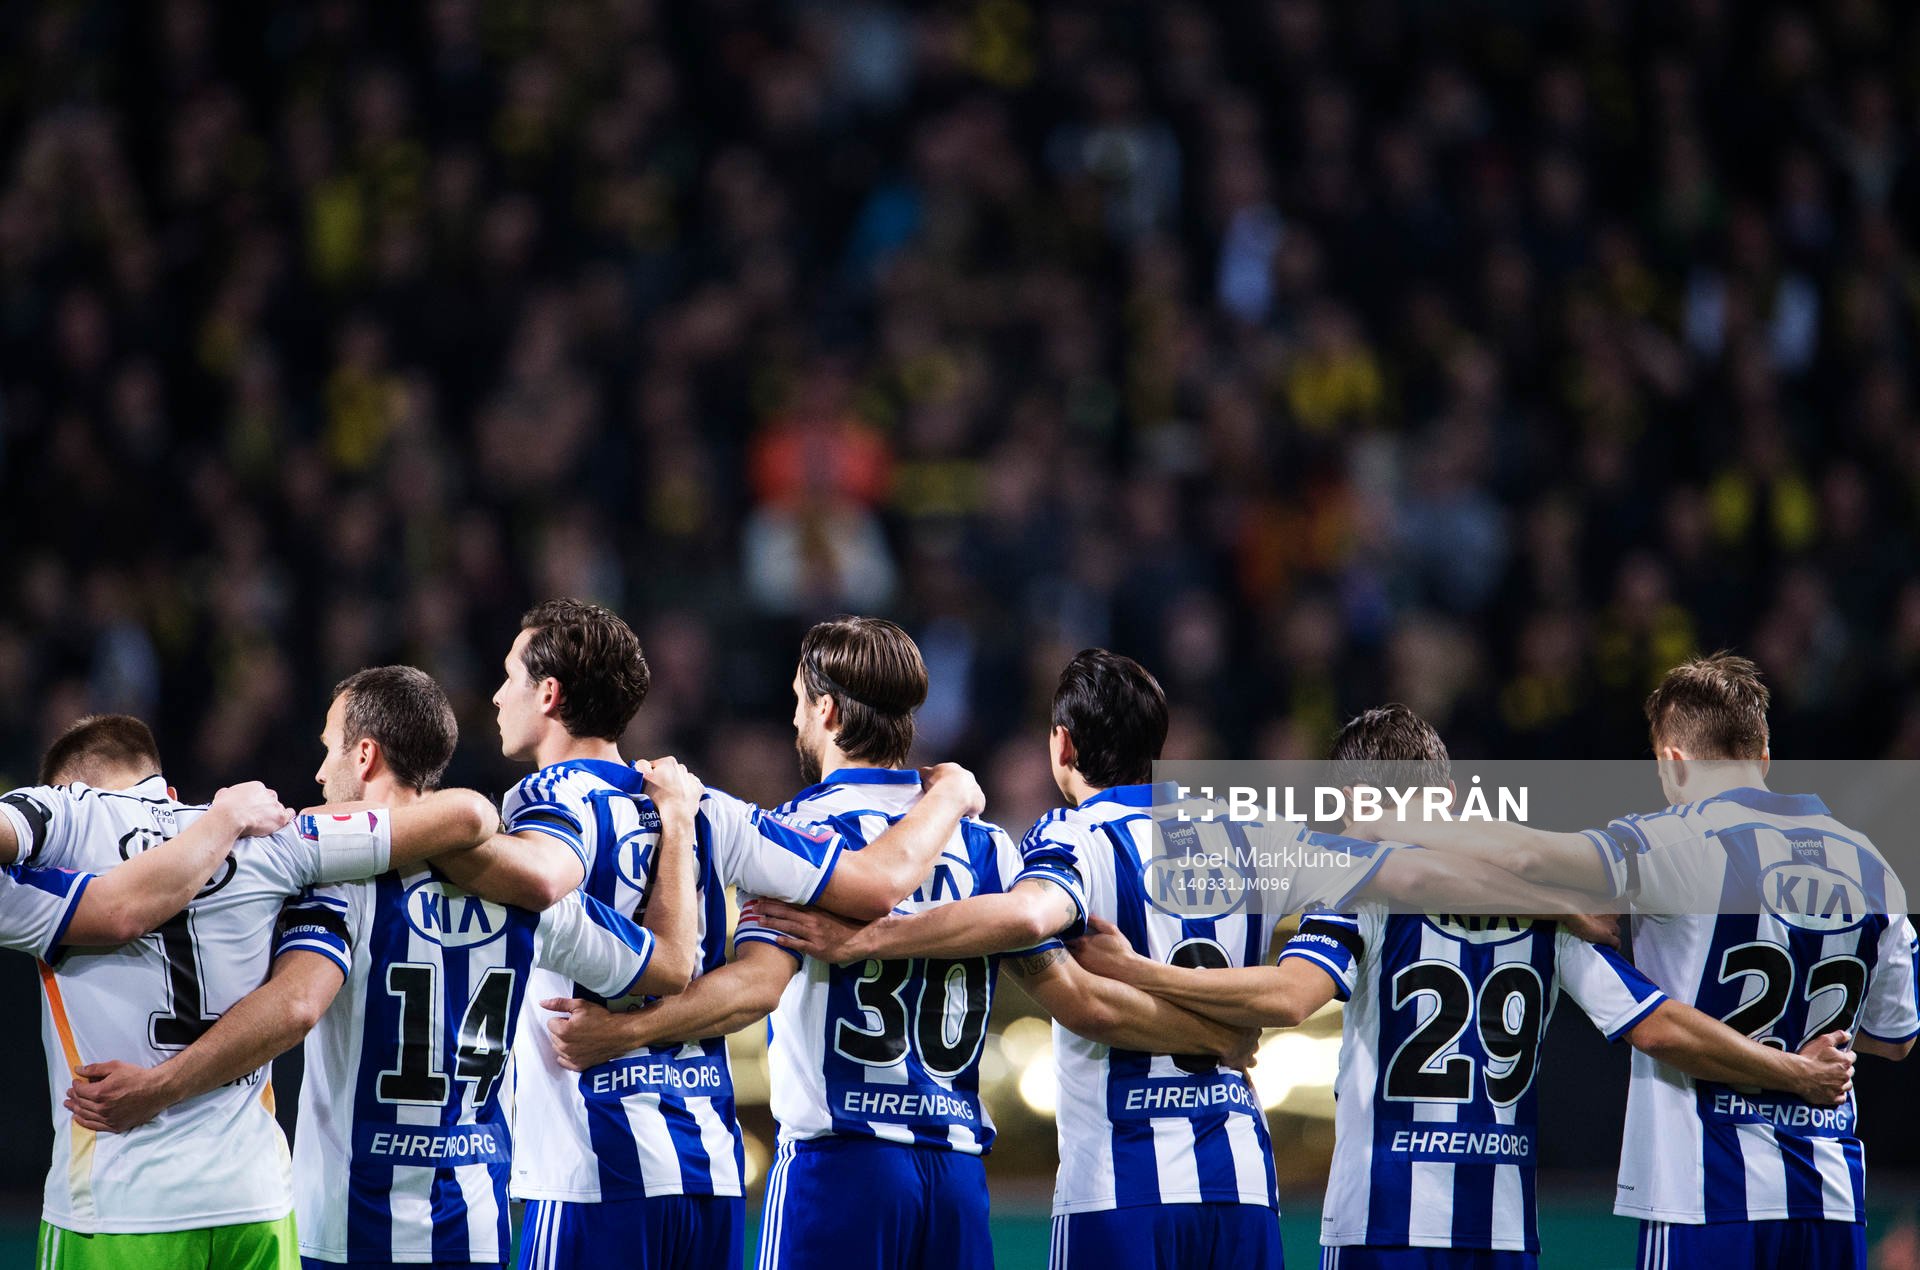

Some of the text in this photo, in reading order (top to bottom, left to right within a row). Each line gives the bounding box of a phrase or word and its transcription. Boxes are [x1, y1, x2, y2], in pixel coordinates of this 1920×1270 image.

[1157, 865, 1232, 906] KIA
[1776, 872, 1853, 923] KIA
[419, 891, 492, 935] KIA
[147, 907, 222, 1051] 1
[1717, 939, 1867, 1052] 22
[377, 962, 516, 1108] 14
[834, 957, 990, 1078] 30
[1383, 959, 1543, 1108] 29
[593, 1064, 720, 1094] EHRENBORG
[844, 1091, 974, 1120] EHRENBORG
[370, 1132, 497, 1158] EHRENBORG
[1391, 1131, 1529, 1157] EHRENBORG
